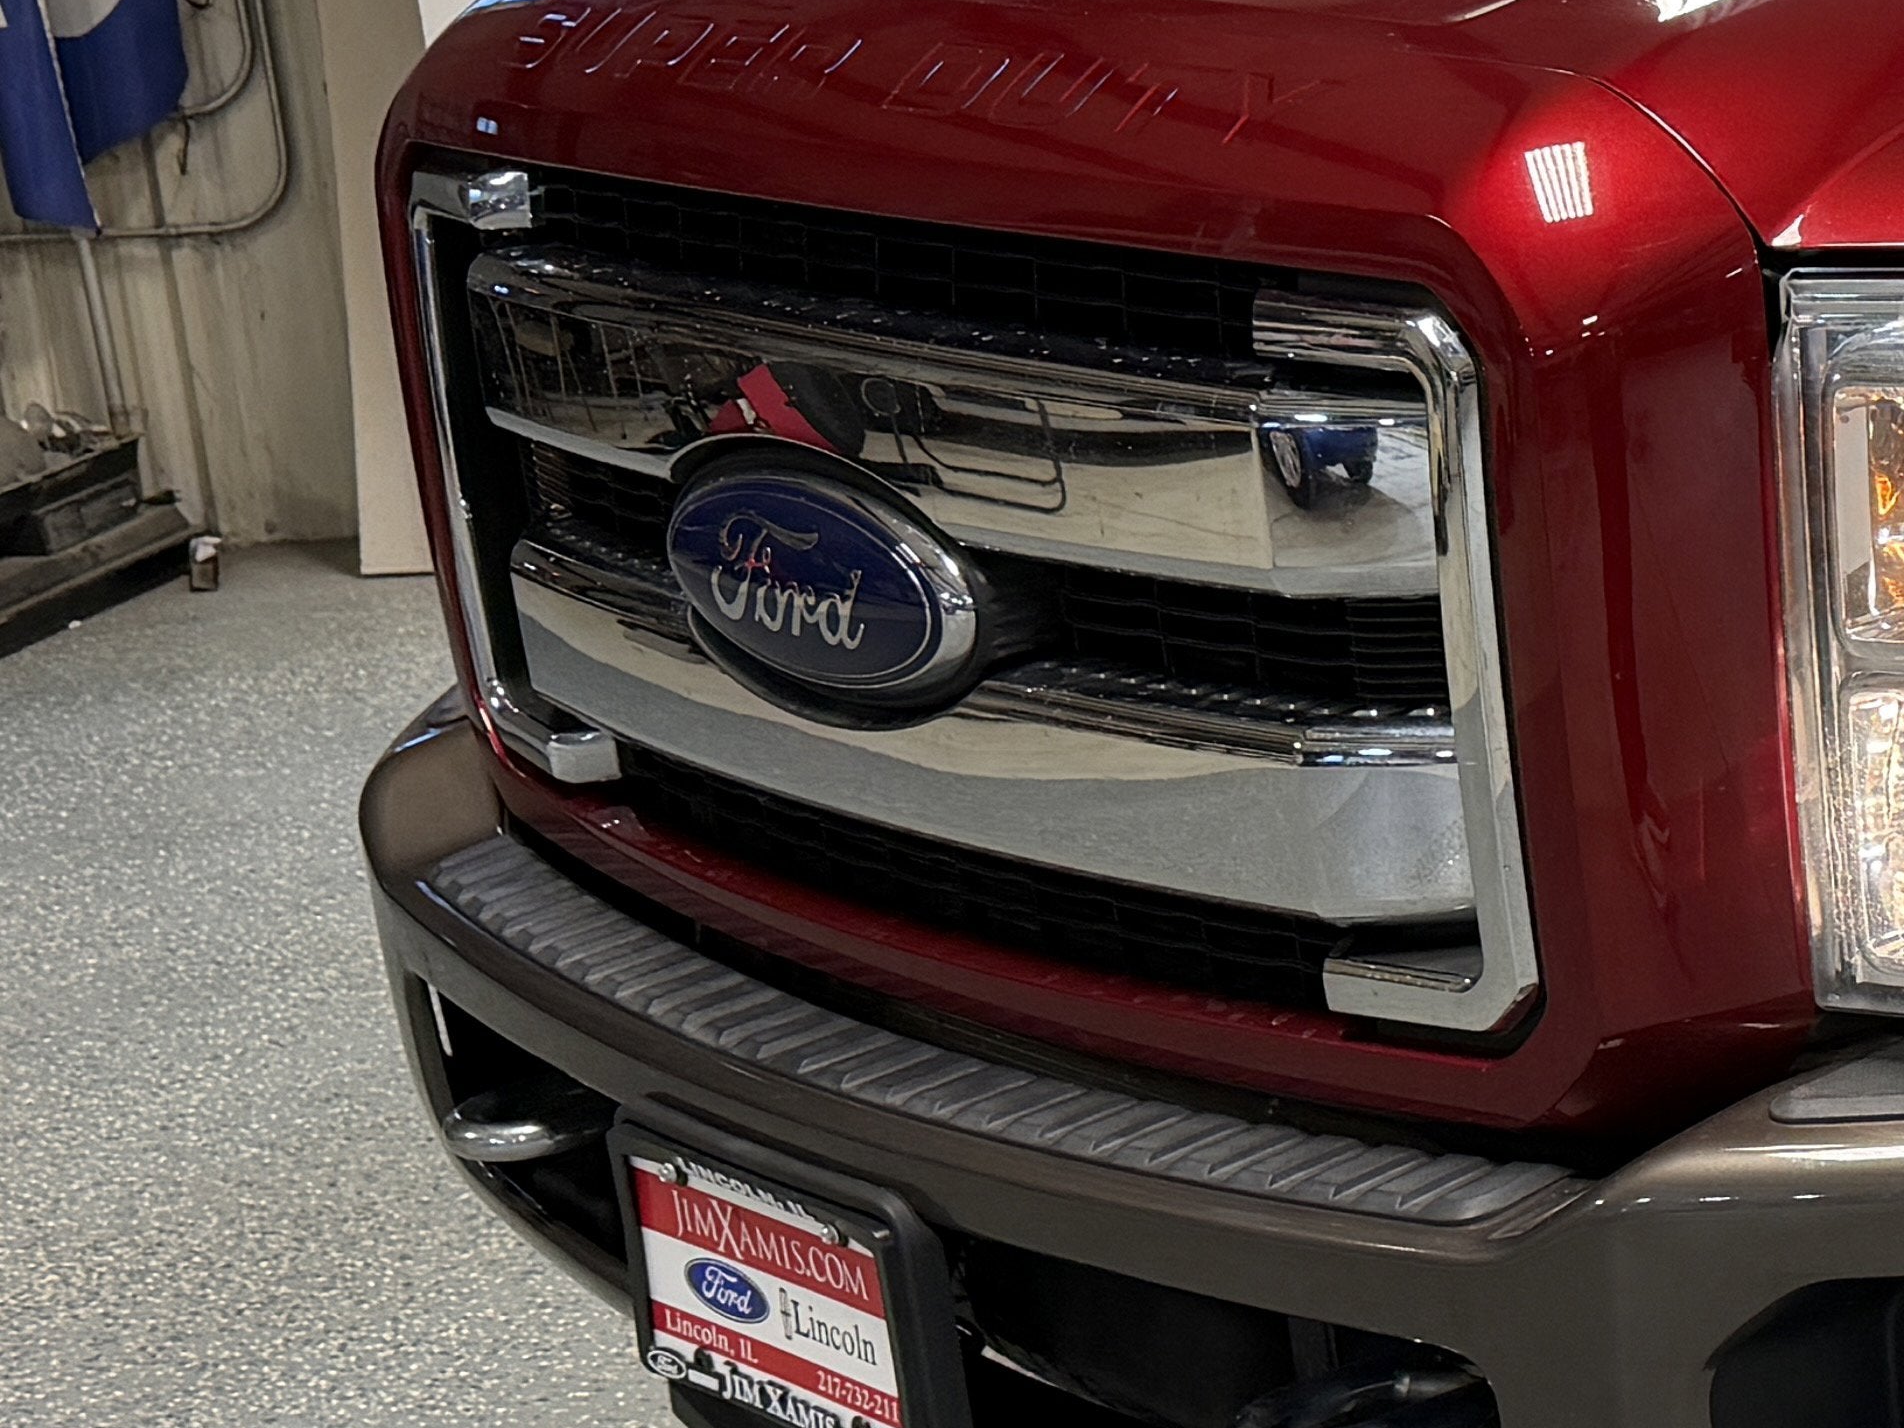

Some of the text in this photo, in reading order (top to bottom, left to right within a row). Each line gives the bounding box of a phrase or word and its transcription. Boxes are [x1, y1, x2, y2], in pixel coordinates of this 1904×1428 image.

[500, 6, 1348, 146] SUPER DUTY
[711, 509, 866, 650] Ford
[671, 1188, 869, 1301] JIMXAMIS.COM
[701, 1264, 753, 1315] Ford
[664, 1308, 759, 1365] Lincoln, IL
[790, 1298, 878, 1366] Lincoln
[718, 1362, 764, 1410] JIM
[816, 1370, 899, 1422] 217-732-211
